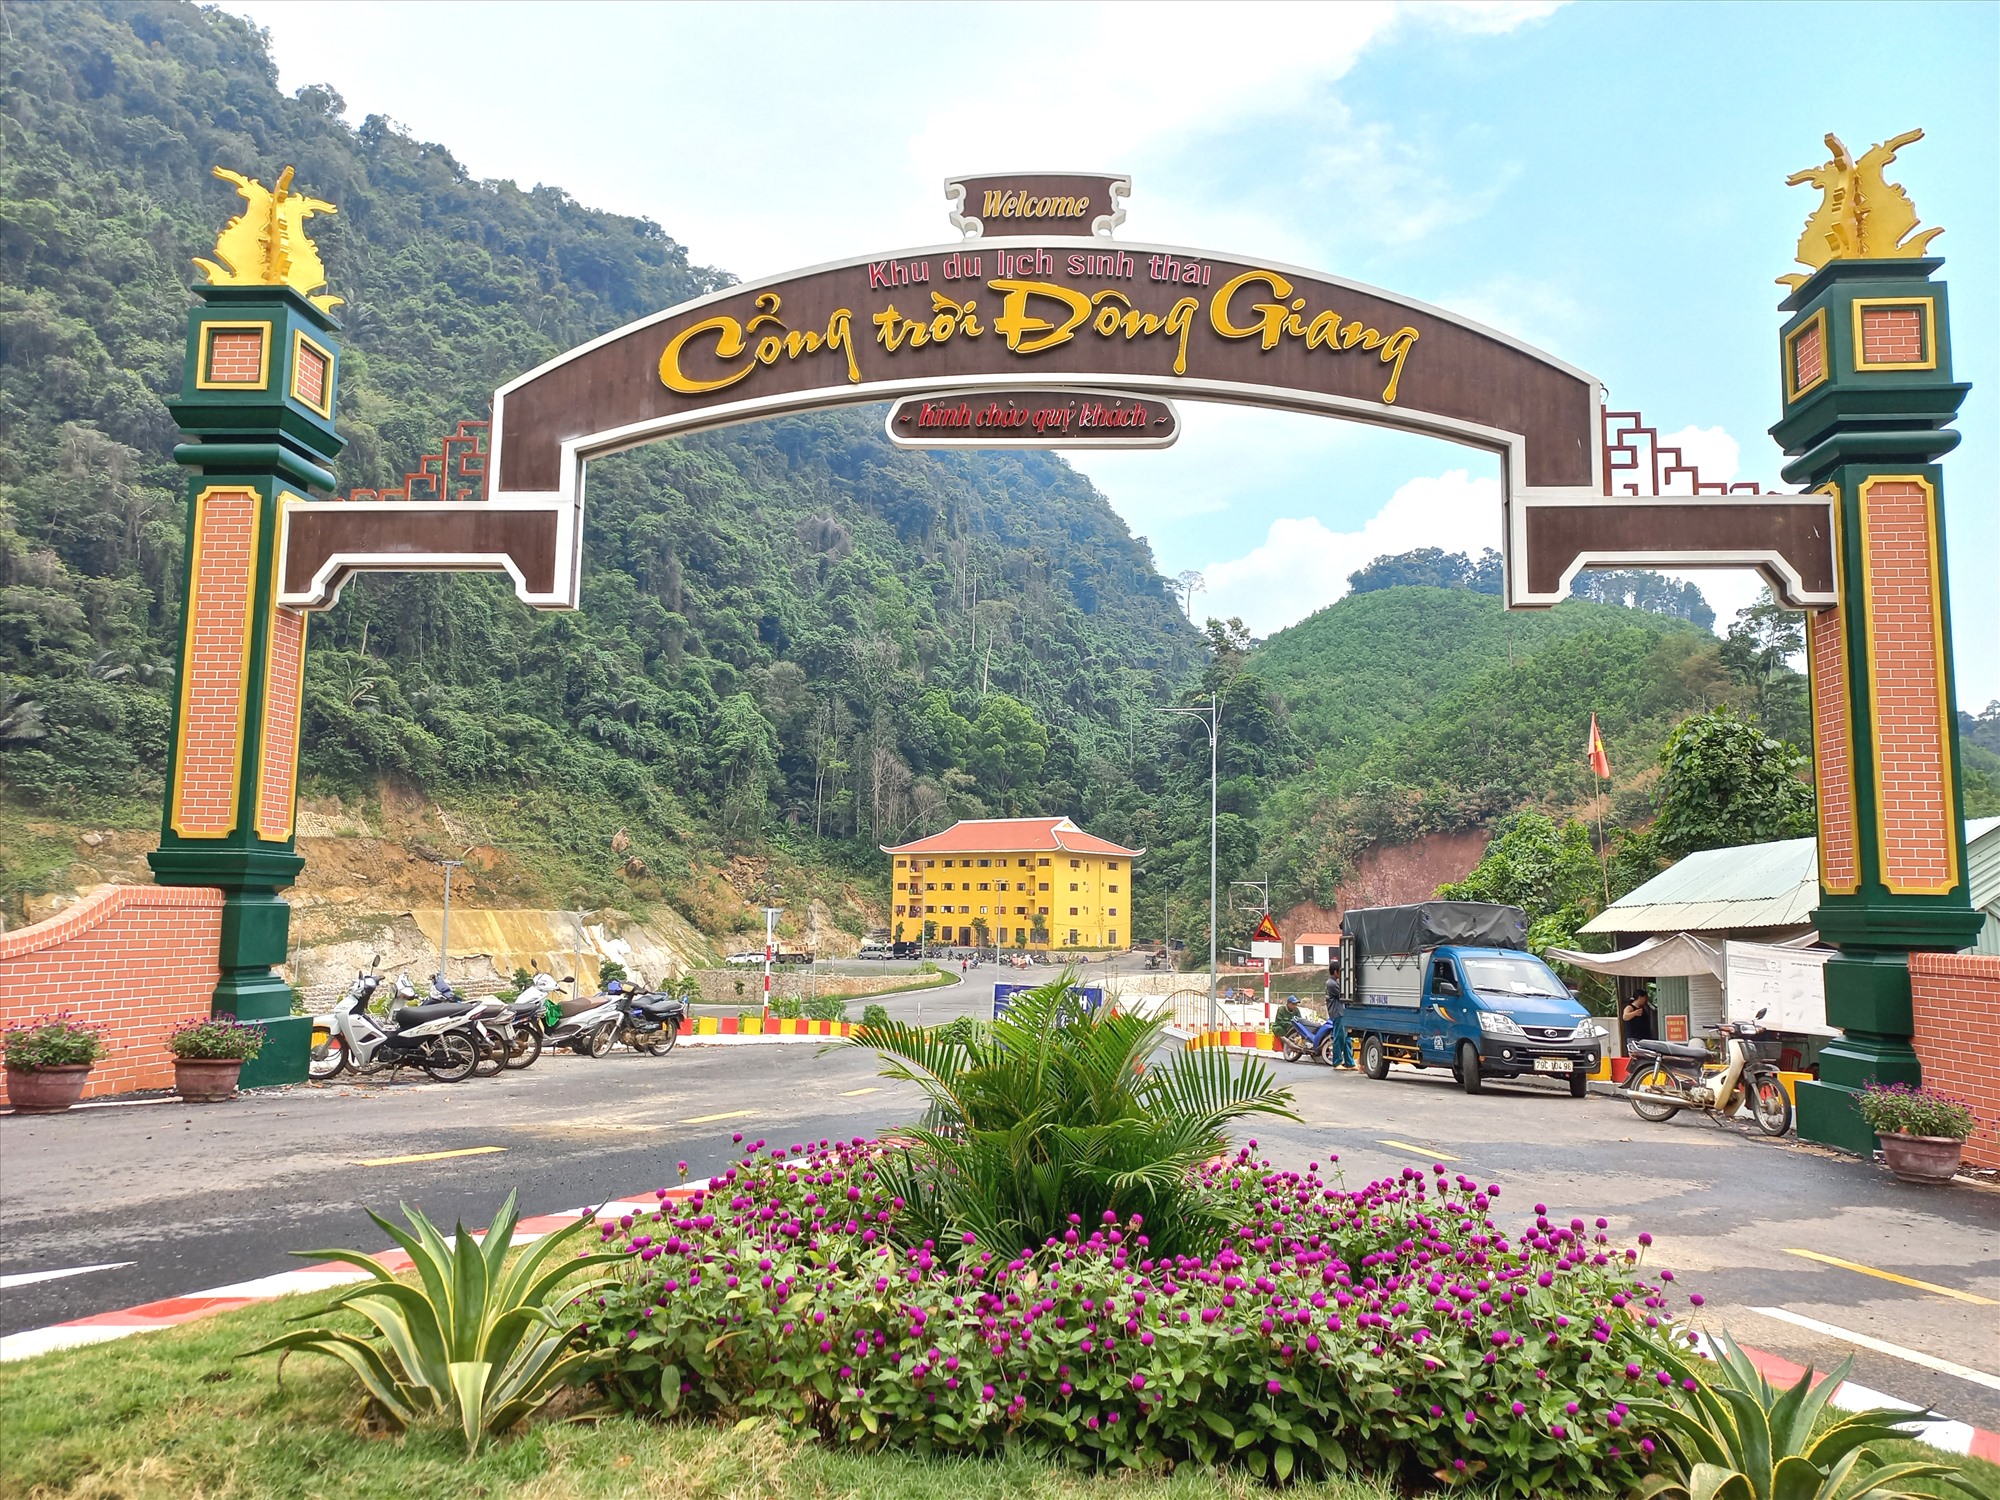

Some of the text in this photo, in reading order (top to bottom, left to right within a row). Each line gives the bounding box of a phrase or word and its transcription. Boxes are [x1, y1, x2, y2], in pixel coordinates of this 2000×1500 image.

[982, 189, 1090, 218] Welcome
[868, 248, 1211, 288] Khu du lịch sinh thái
[659, 269, 1420, 404] Cổng trời Đông Giang
[975, 399, 1029, 428] chào
[1032, 399, 1076, 433] quý
[1078, 399, 1147, 428] khách
